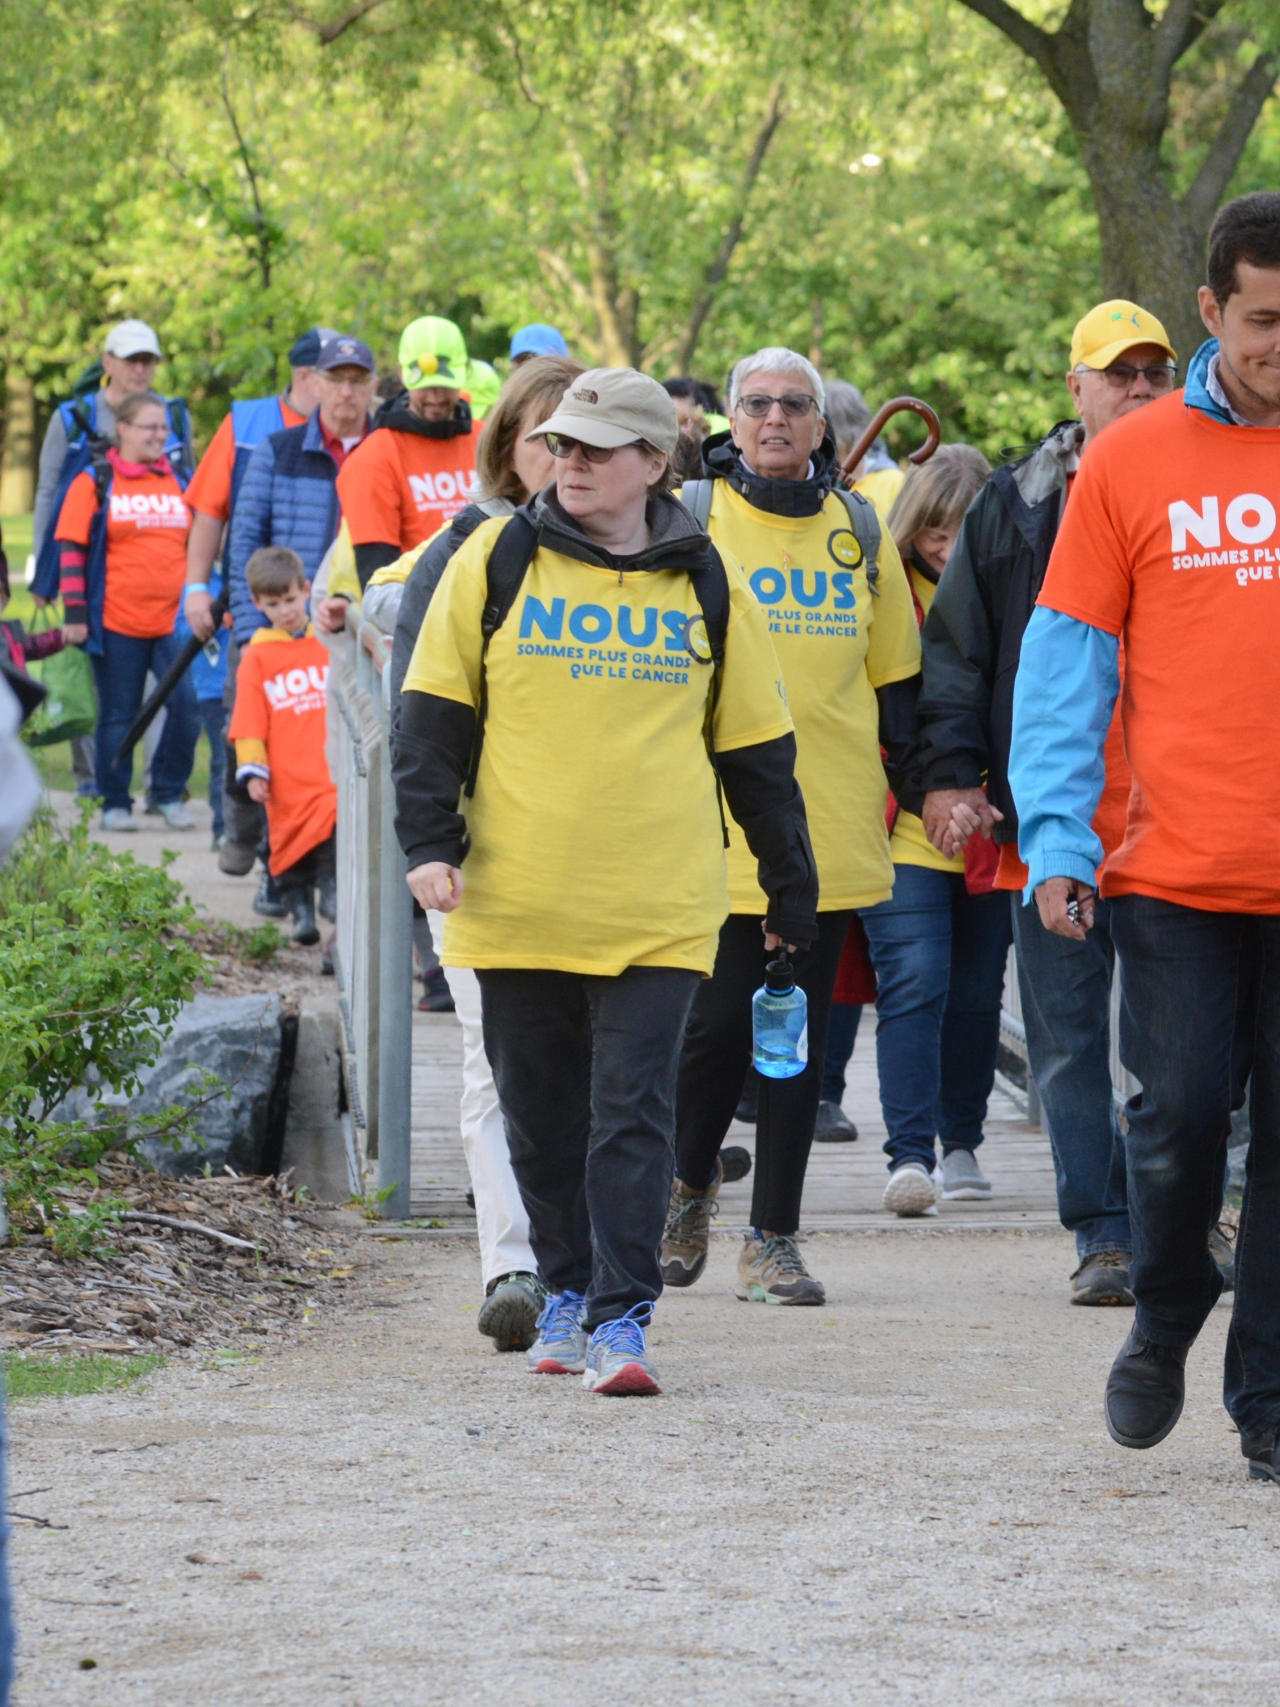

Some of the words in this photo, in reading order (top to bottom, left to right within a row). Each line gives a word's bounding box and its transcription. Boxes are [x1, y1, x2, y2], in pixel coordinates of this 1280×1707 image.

[408, 469, 481, 503] NOU
[110, 493, 185, 514] NOUS
[1172, 549, 1249, 570] SOMMES
[1235, 566, 1273, 586] QUE
[741, 566, 857, 610] OUS
[519, 594, 689, 652] NOUS
[767, 609, 802, 621] PLUS
[805, 611, 858, 624] GRANDS
[785, 623, 802, 634] LE
[805, 625, 858, 637] CANCER
[517, 643, 584, 659] SOMMES
[588, 648, 628, 663] PLUS
[632, 652, 691, 669] GRANDS
[570, 663, 604, 680] QUE
[608, 666, 627, 679] LE
[631, 668, 689, 685] CANCER
[263, 666, 329, 706] NOU
